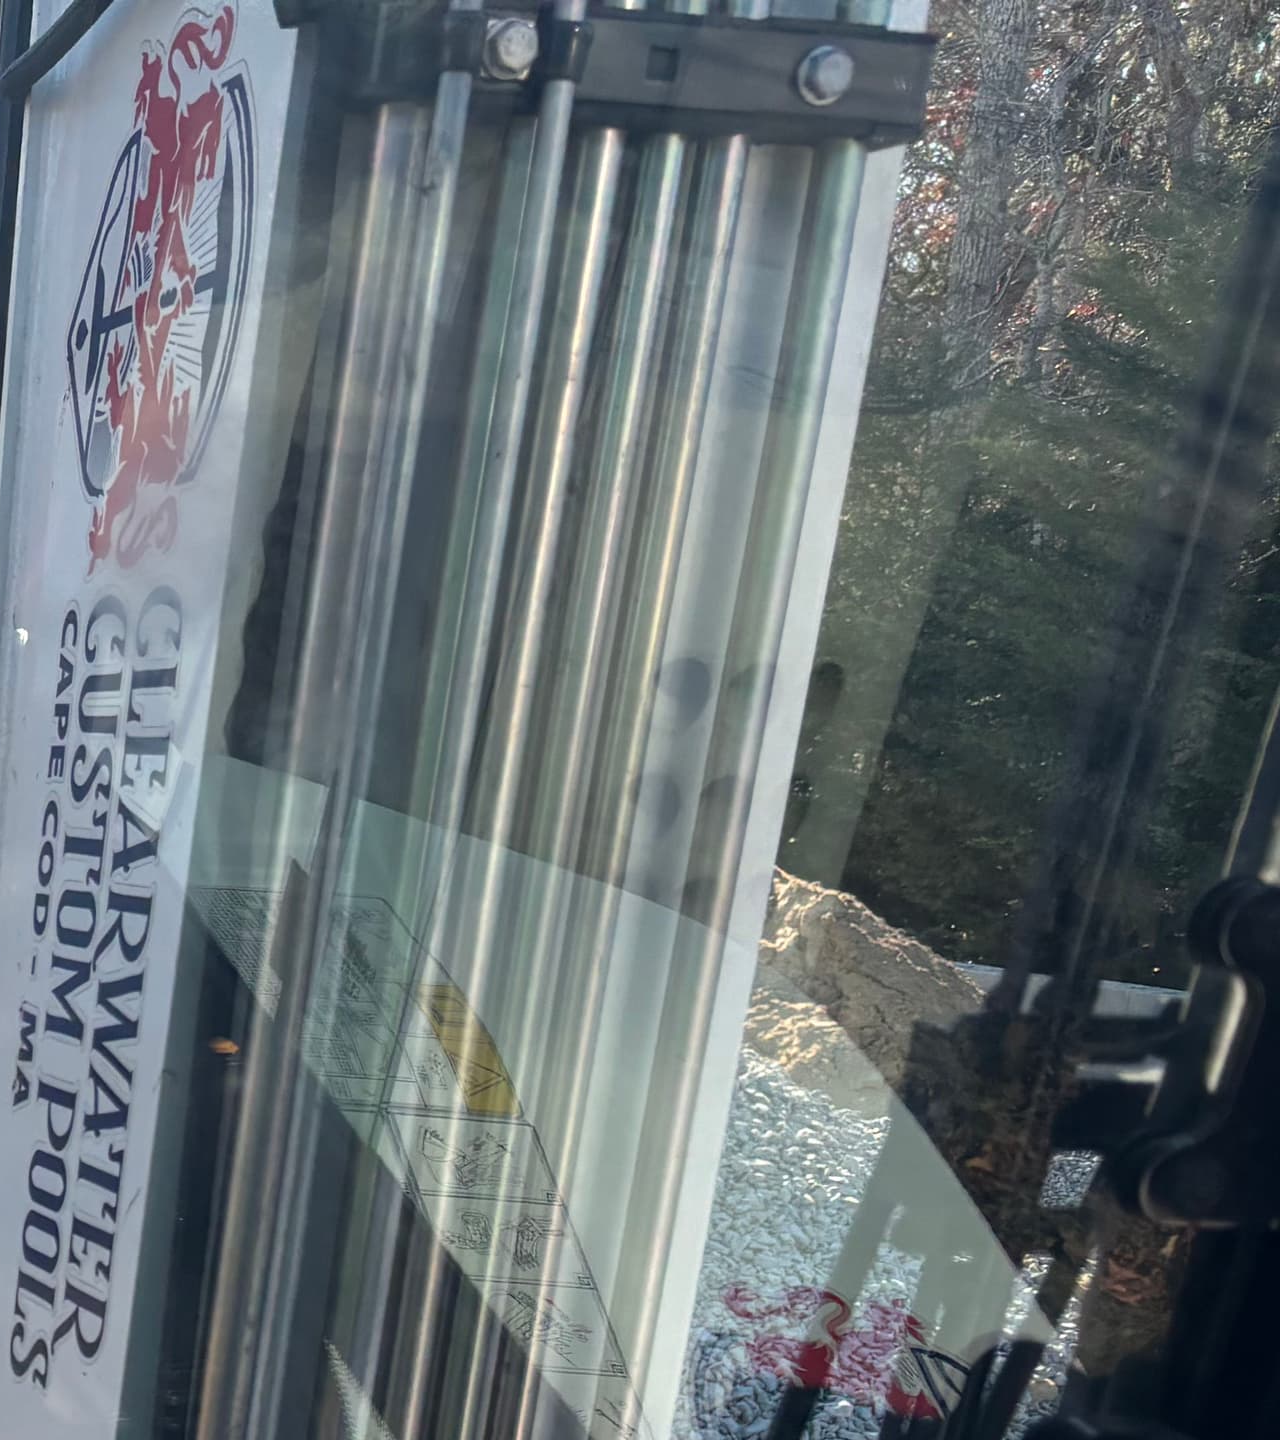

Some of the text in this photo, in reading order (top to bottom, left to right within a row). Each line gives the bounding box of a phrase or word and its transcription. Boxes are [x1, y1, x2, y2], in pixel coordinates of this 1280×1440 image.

[46, 609, 78, 779] CAPE
[33, 800, 57, 937] COD
[10, 595, 127, 1390] CUSTOM POOLS
[12, 1005, 37, 1107] MA
[51, 585, 183, 1360] CLEARWATER
